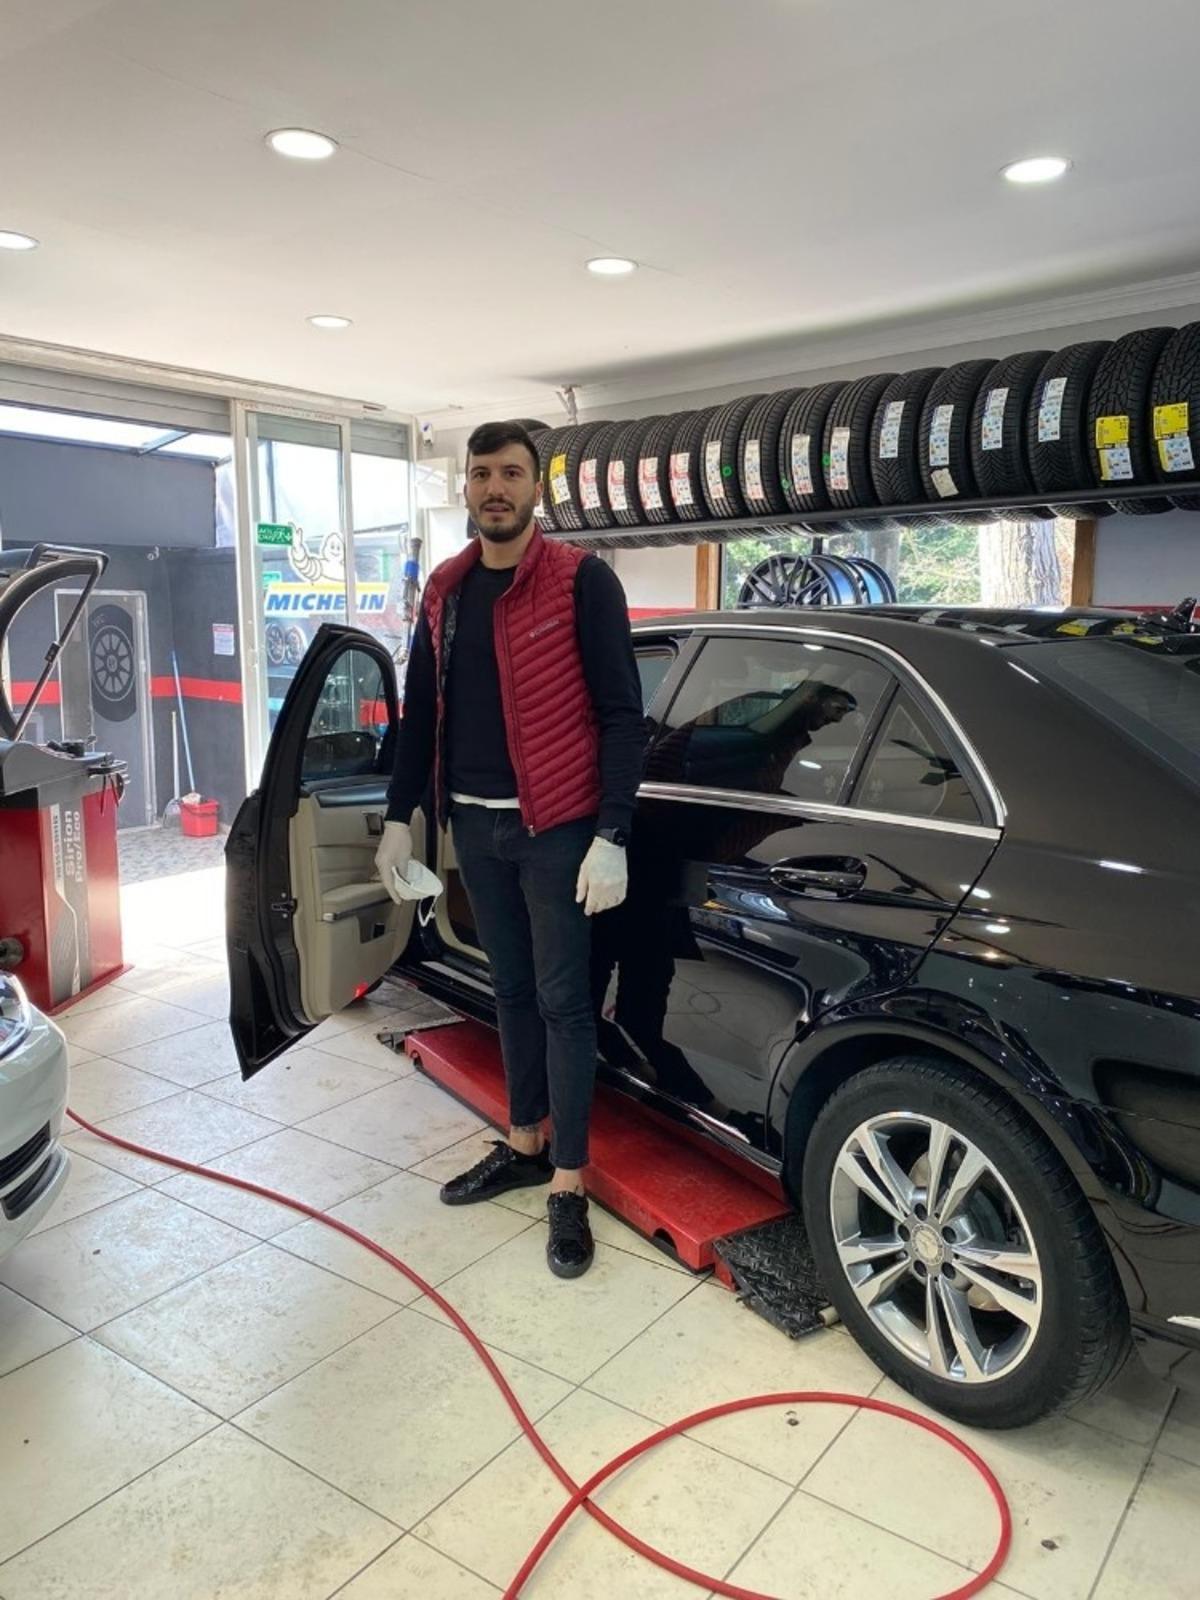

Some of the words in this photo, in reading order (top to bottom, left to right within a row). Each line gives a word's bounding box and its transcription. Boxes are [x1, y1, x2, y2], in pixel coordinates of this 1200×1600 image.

[266, 594, 385, 611] MICHEIN
[64, 811, 74, 876] Sirion
[73, 811, 82, 882] Pro/Eco
